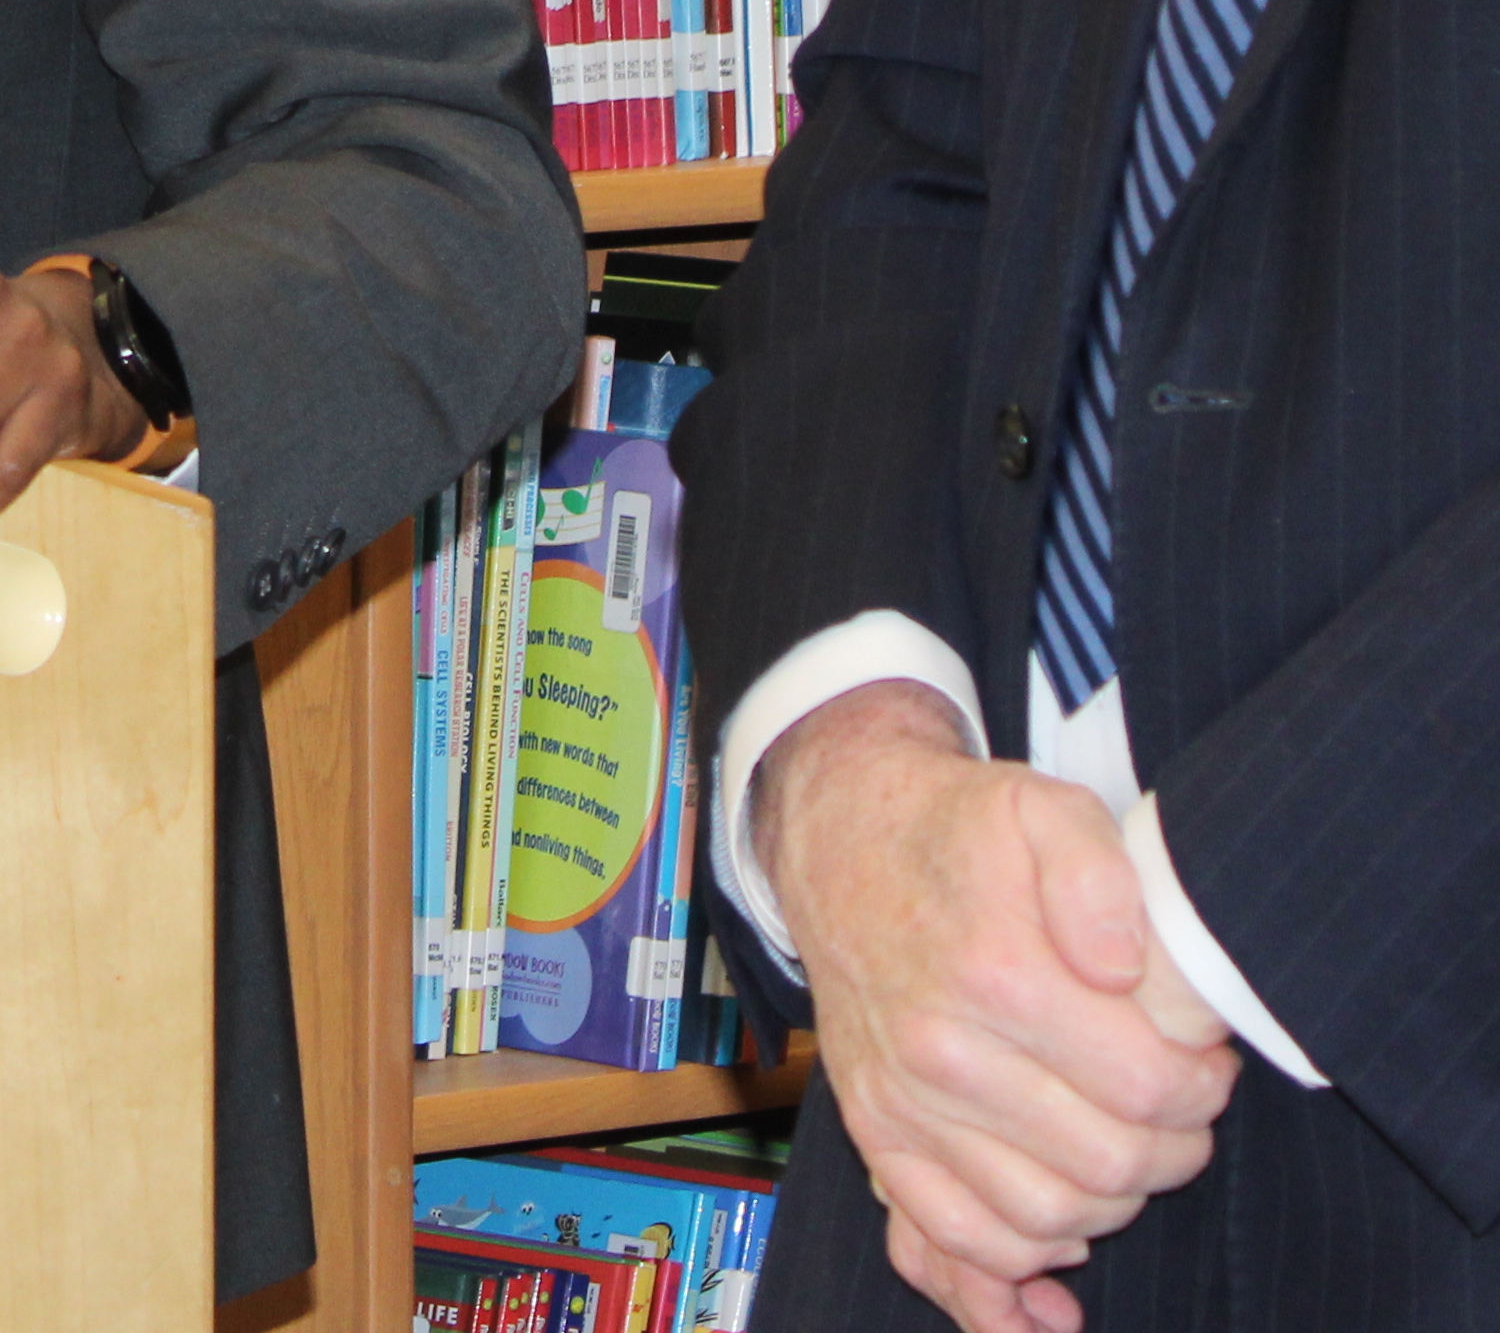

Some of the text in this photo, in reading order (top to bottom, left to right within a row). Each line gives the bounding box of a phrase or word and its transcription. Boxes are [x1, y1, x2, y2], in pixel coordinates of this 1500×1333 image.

[433, 649, 449, 758] CELL SYSTEMS
[481, 569, 511, 850] THE SCIENTISTS BEHIND LIVING THINGS
[577, 791, 621, 831] between
